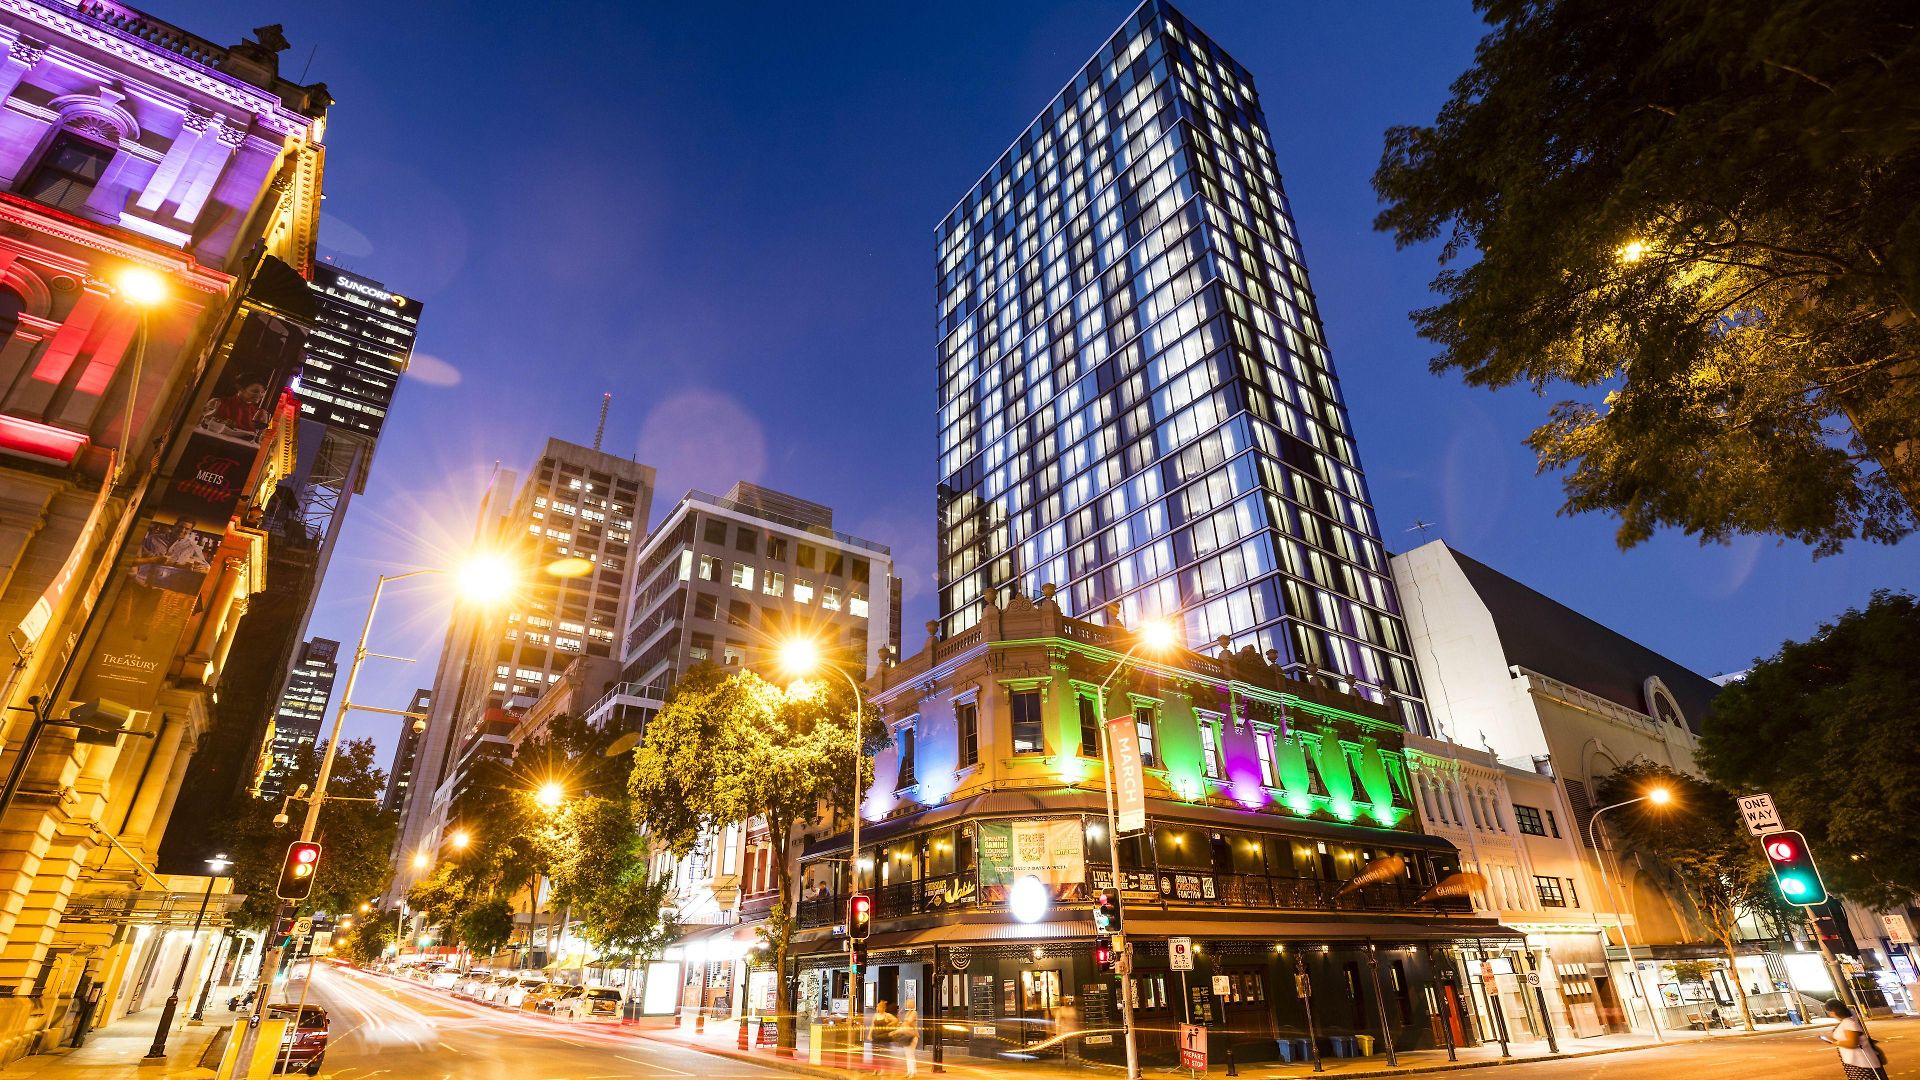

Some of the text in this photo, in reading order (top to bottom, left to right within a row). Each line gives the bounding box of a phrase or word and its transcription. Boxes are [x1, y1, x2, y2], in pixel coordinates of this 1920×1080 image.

[336, 276, 391, 301] SUNCORP
[196, 469, 224, 485] MEETS
[103, 653, 159, 671] TREASURY
[1119, 737, 1137, 803] MARCH
[1744, 797, 1769, 810] ONE
[1746, 809, 1772, 822] WAY
[984, 841, 1008, 849] GAMING
[1093, 870, 1107, 881] LIVE
[299, 922, 309, 930] 40
[1183, 1050, 1204, 1061] PREPARE
[1191, 1060, 1204, 1068] STOP
